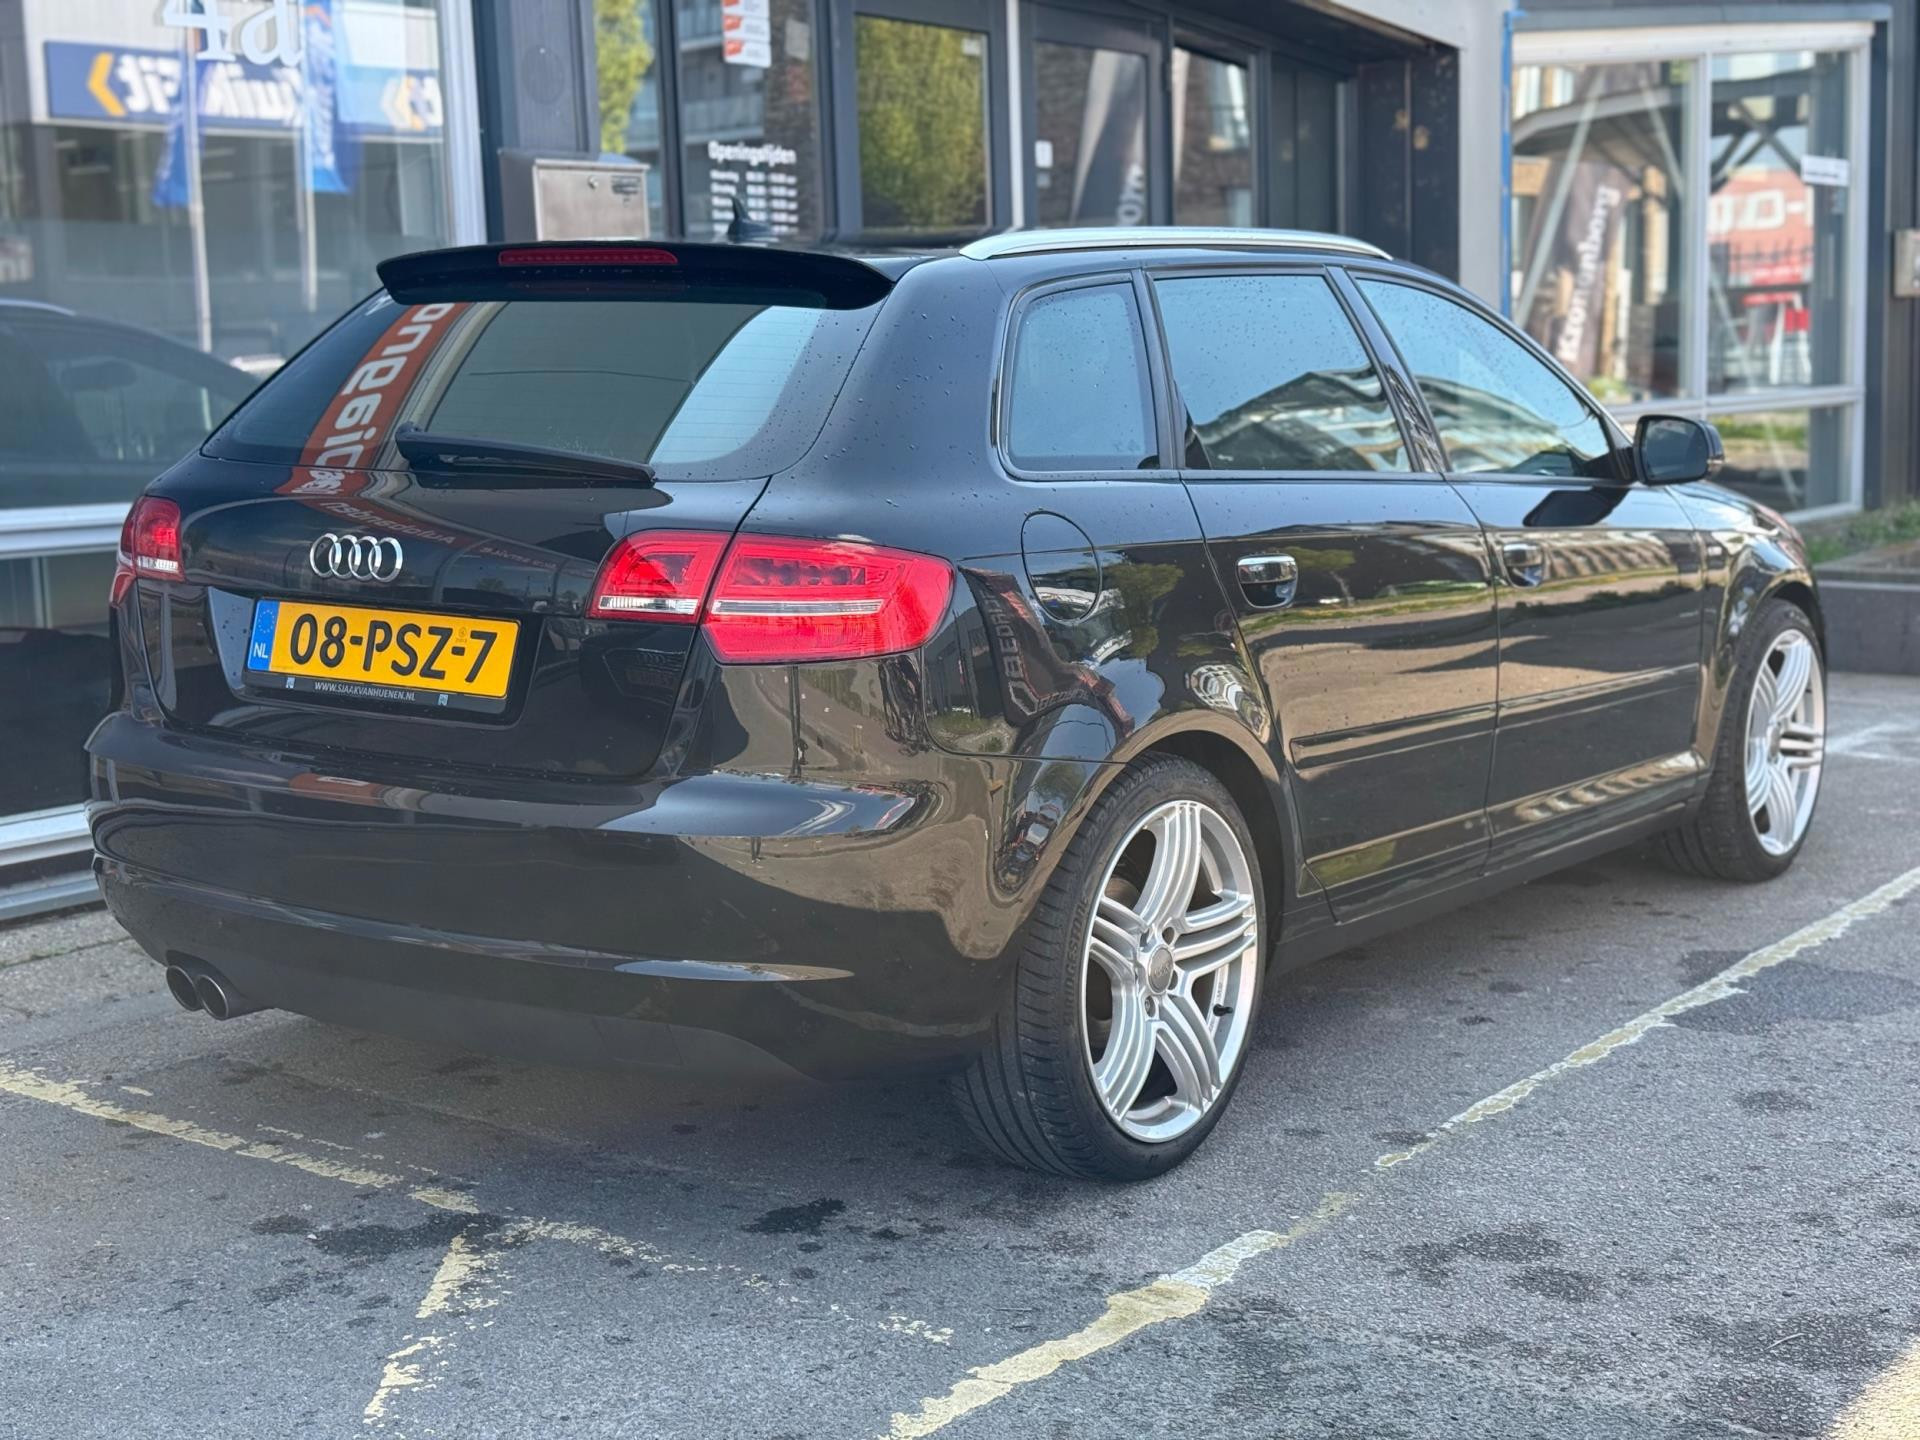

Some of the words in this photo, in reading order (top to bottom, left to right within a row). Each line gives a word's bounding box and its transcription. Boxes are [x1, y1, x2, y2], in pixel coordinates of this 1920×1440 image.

[252, 642, 269, 659] NL
[289, 612, 498, 684] 08-PSZ-7
[314, 681, 416, 702] WWW.SJAAKVANHUENEN.NL
